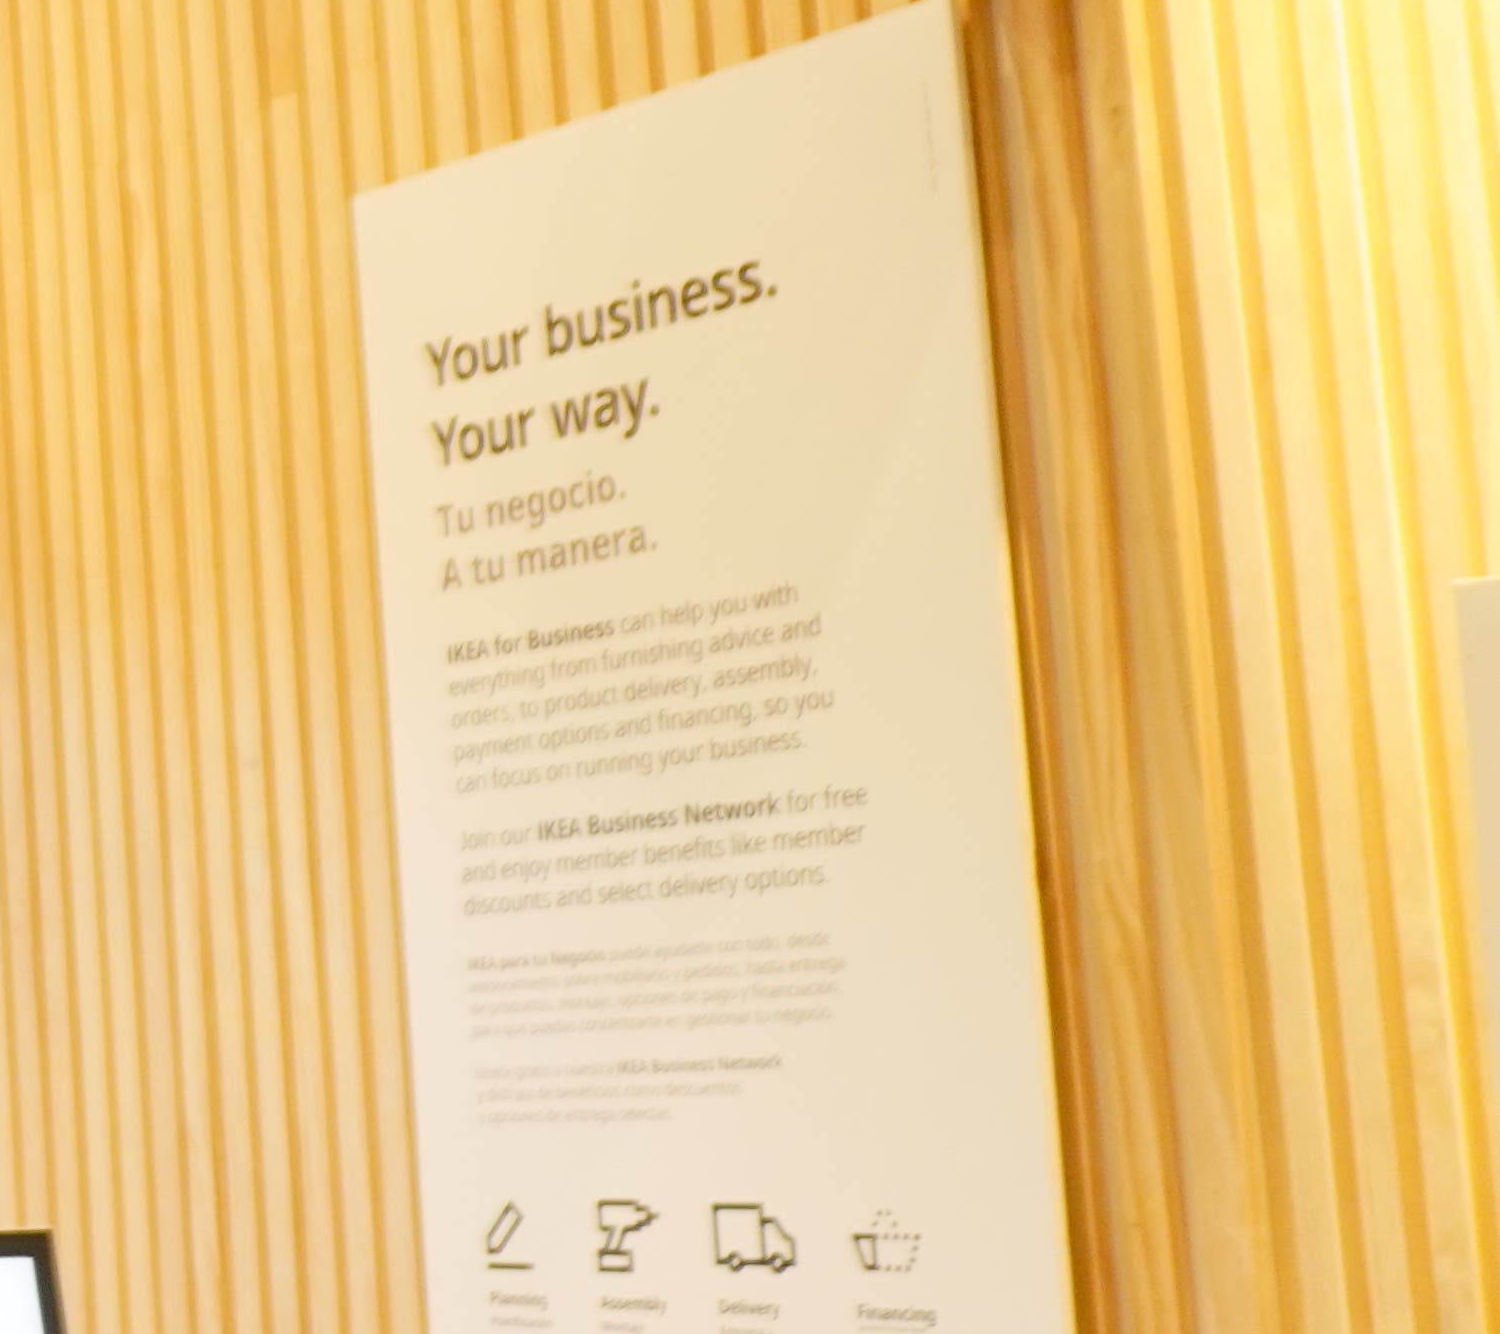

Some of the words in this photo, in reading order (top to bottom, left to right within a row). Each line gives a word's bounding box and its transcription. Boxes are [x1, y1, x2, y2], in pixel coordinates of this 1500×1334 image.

[424, 326, 529, 386] Your
[544, 260, 778, 357] business.
[432, 407, 535, 467] Your
[550, 377, 660, 440] way.
[435, 503, 475, 536] Tu
[486, 471, 627, 529] negocio.
[441, 558, 463, 591] A
[471, 557, 504, 586] tu
[516, 524, 658, 576] manera.
[446, 639, 490, 665] IKEA
[492, 634, 522, 657] for
[526, 620, 615, 651] Business
[618, 612, 655, 636] can
[658, 602, 705, 628] help
[708, 596, 749, 626] you
[751, 583, 799, 611] with
[447, 665, 547, 697] everything
[548, 656, 598, 680] from
[600, 638, 705, 673] furnishing
[708, 626, 775, 655] advice
[780, 613, 822, 644] and
[452, 733, 534, 765] payment
[537, 723, 610, 752] options
[613, 713, 653, 739] and
[762, 696, 790, 719] so
[793, 691, 835, 720] you
[517, 699, 541, 721] to
[542, 686, 619, 720] product
[454, 773, 489, 796] can
[490, 766, 542, 790] focus
[544, 762, 572, 784] on
[575, 751, 655, 778] running
[657, 743, 705, 774] your
[498, 826, 533, 848] our
[536, 817, 583, 842] IKEA
[586, 810, 679, 837] Business
[683, 796, 779, 825] Network
[785, 788, 818, 814] for
[822, 784, 868, 809] free
[460, 860, 498, 885] and
[498, 859, 552, 884] enjoy
[555, 848, 638, 873] member
[642, 836, 726, 866] benefits
[729, 833, 767, 856] like
[771, 824, 864, 851] member
[462, 891, 552, 917] discounts
[555, 885, 594, 909] and
[597, 881, 654, 905] select
[657, 874, 739, 899] delivery
[718, 1299, 780, 1320] Delivery
[856, 1303, 938, 1329] Financing
